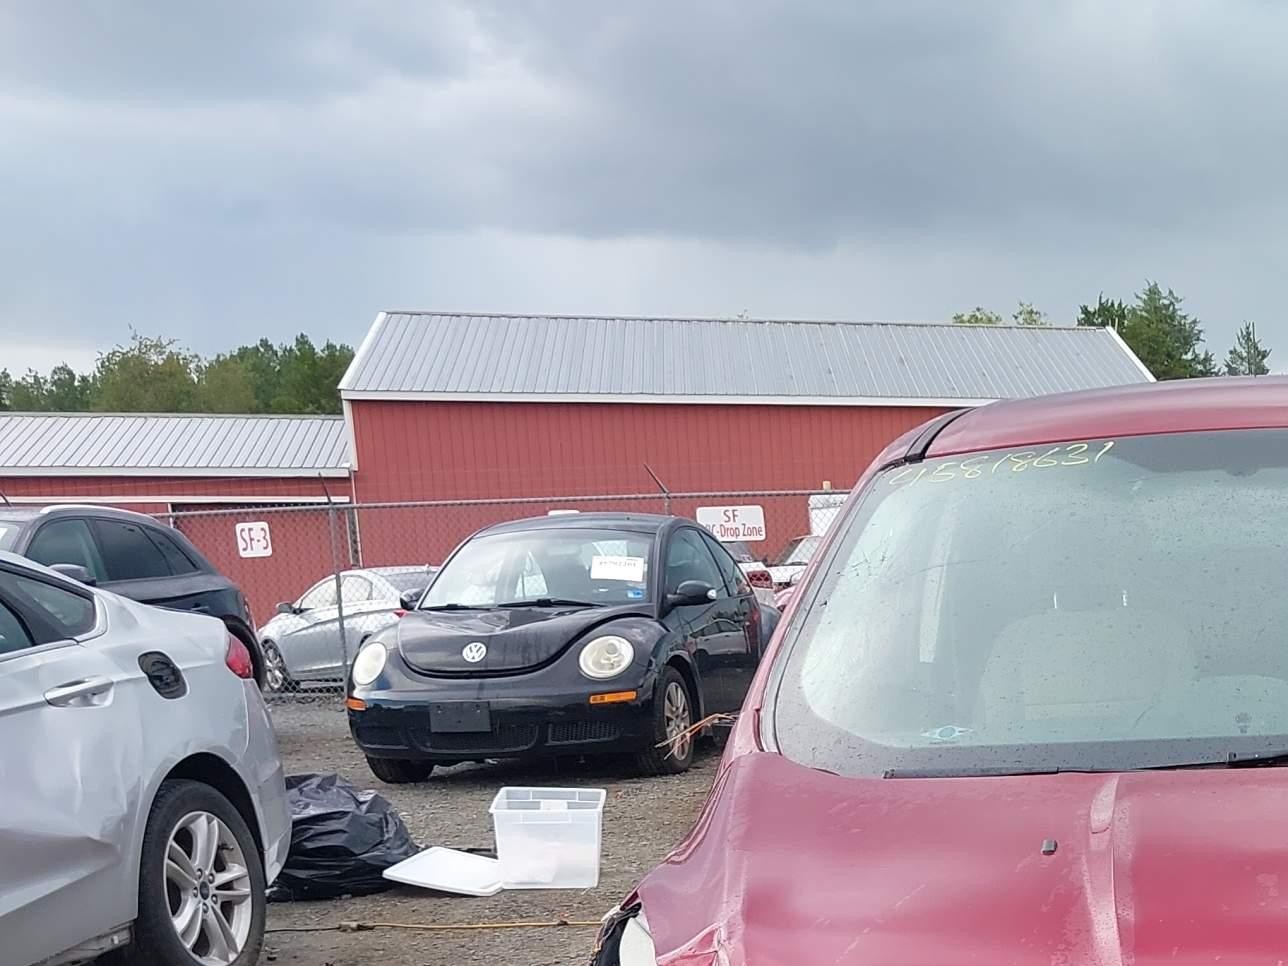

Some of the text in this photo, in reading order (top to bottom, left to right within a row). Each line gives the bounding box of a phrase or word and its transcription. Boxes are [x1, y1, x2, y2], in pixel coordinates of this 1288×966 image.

[889, 441, 1115, 488] 45818631
[723, 509, 739, 523] SF
[240, 527, 269, 552] SF-3
[742, 523, 764, 537] Zone
